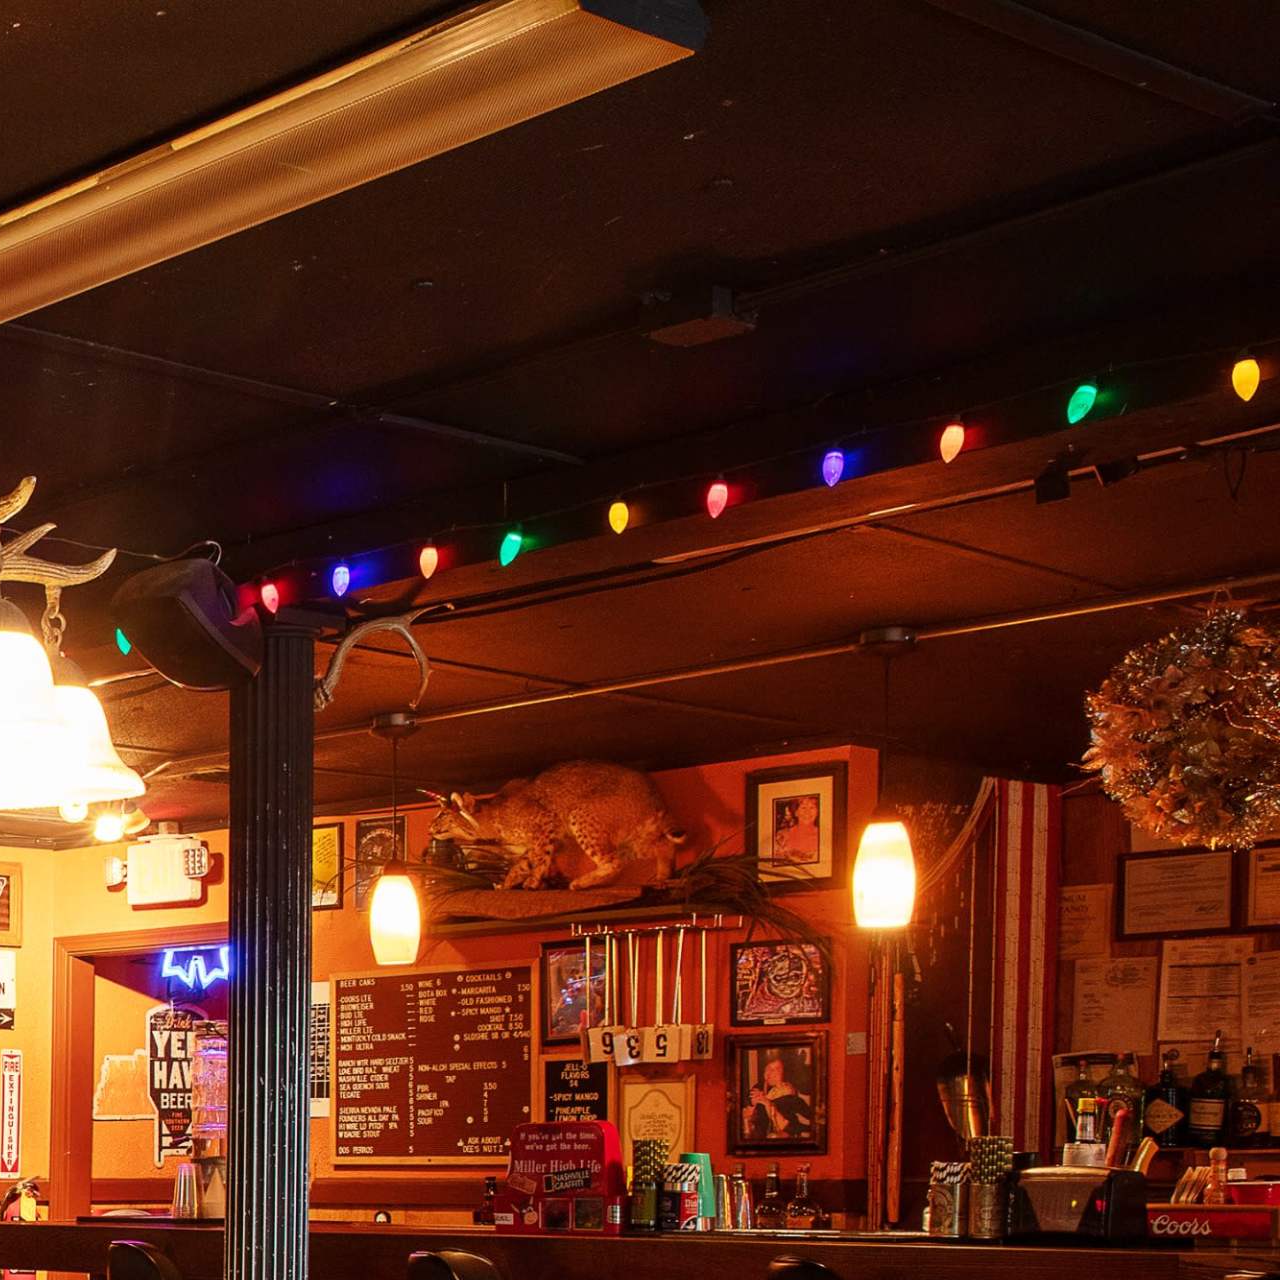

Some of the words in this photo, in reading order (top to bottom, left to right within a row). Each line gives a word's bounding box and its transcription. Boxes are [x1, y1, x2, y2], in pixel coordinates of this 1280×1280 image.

[340, 979, 357, 988] BEER
[359, 978, 376, 986] CANS
[465, 973, 502, 983] COCKTAILS
[655, 1033, 667, 1057] 5
[561, 1071, 590, 1080] FLAVORS
[575, 1092, 600, 1101] MANGO
[7, 1074, 16, 1166] EXTINGUISHER
[467, 1136, 480, 1145] ASK
[481, 1136, 501, 1144] ABOUT
[565, 1131, 577, 1140] the
[546, 1143, 557, 1151] got
[513, 1159, 546, 1173] Miller
[1149, 1215, 1213, 1236] Coors
